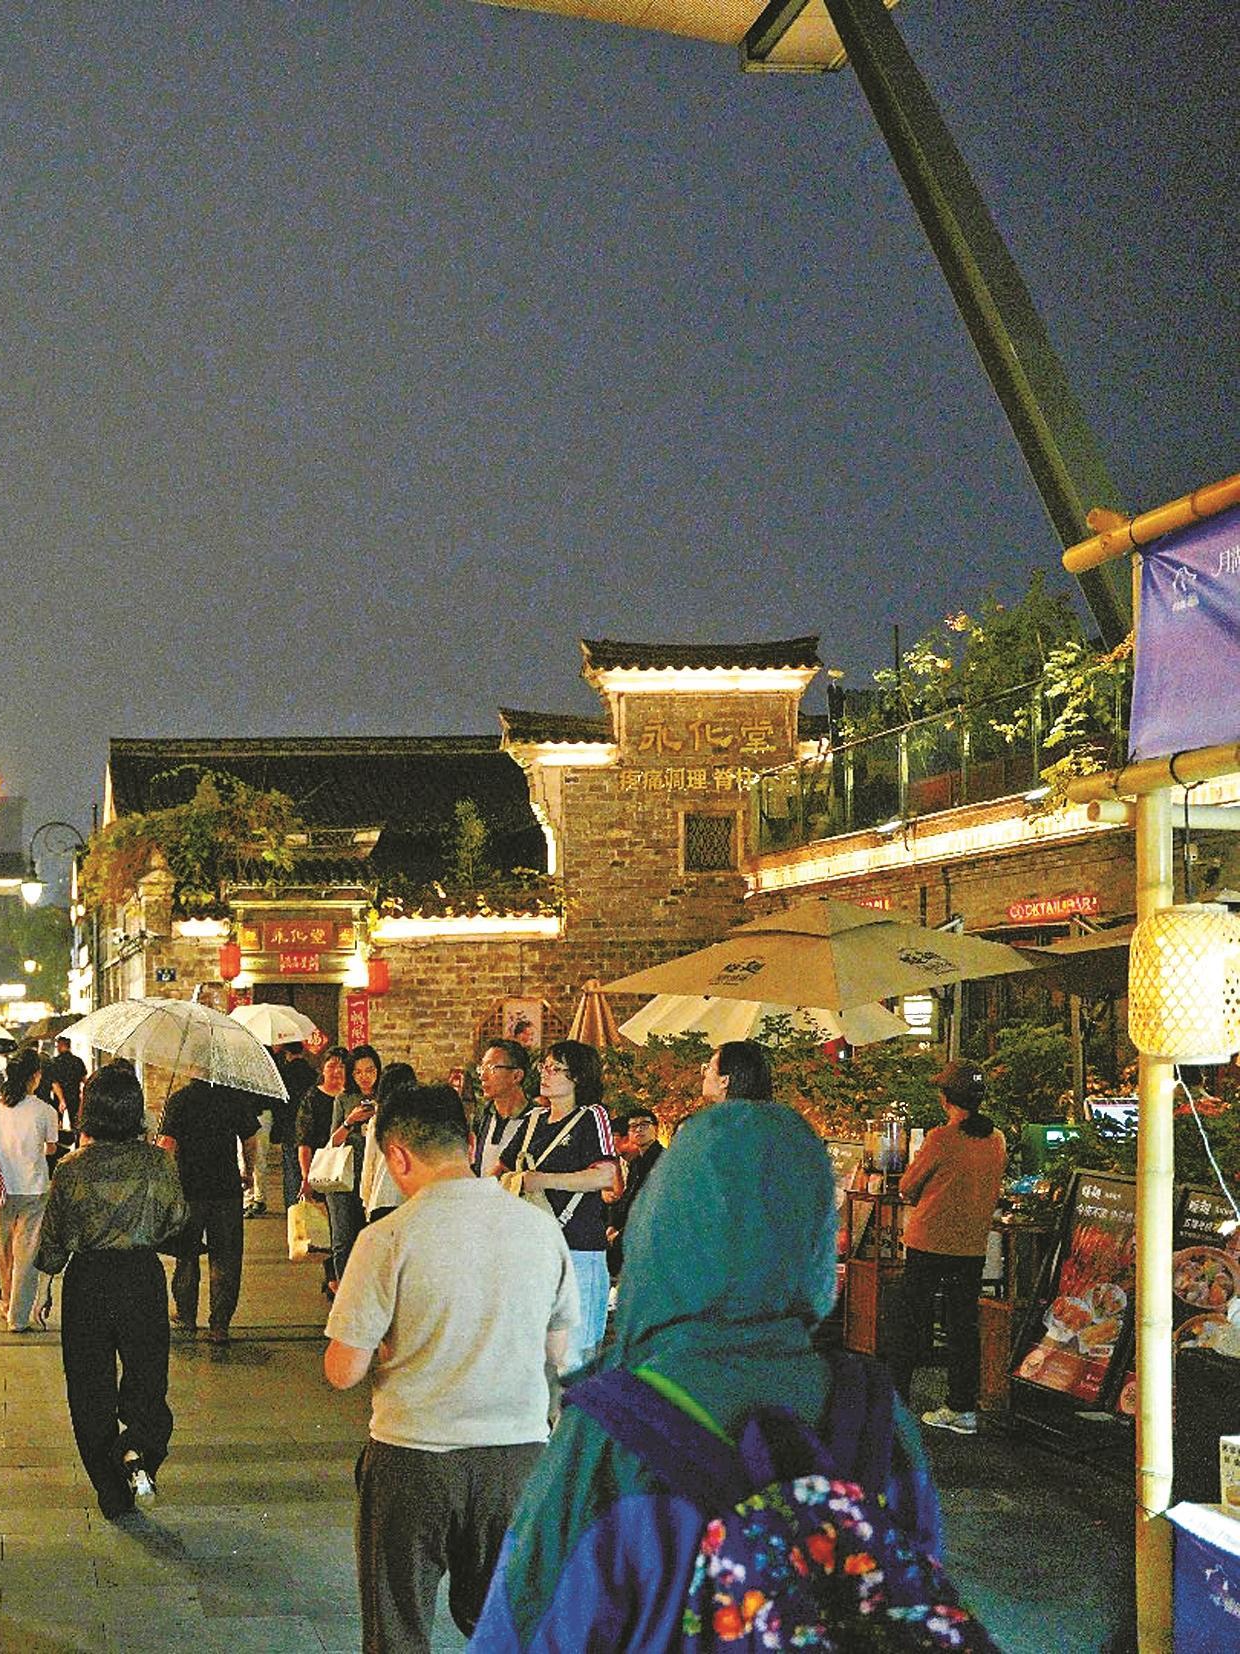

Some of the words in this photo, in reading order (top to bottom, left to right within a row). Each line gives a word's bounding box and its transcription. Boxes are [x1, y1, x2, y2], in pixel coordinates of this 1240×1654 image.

[639, 718, 777, 752] 永化堂
[1009, 901, 1063, 919] COCKTAIL
